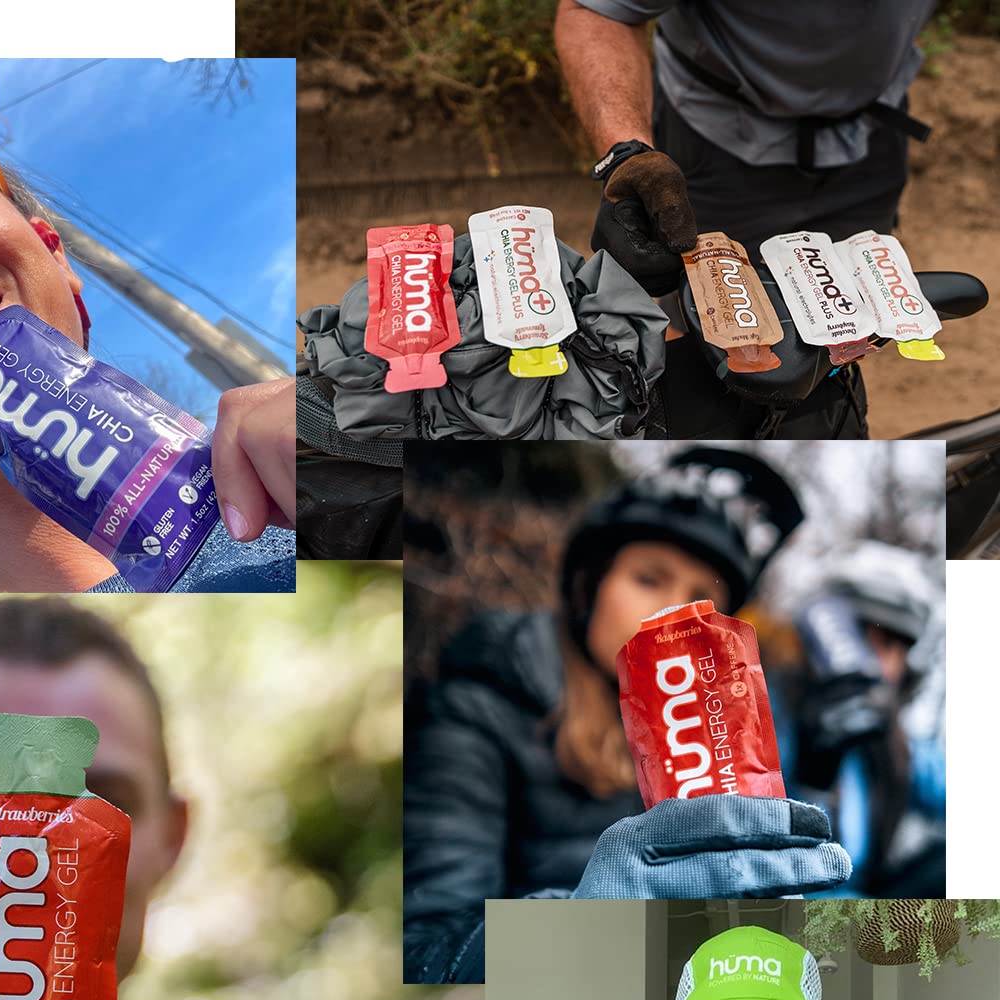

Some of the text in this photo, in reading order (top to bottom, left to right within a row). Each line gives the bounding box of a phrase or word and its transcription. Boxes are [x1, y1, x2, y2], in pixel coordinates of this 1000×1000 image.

[391, 255, 403, 335] CHIA ENERGY GEL
[501, 229, 523, 319] CHIA ENERGY GEL PLUS
[706, 260, 735, 328] CHIA ENERGY GEL
[793, 248, 834, 320] CHIA ENERGY GEL PLUS
[862, 250, 900, 317] CHIA ENERGY GEL PLUS
[17, 363, 88, 412] ENERGY
[87, 404, 134, 442] CHIA
[191, 464, 209, 485] VEGAN
[196, 467, 213, 490] FRIEND
[153, 507, 175, 534] GLUTEN
[159, 523, 175, 539] FREE
[165, 539, 182, 559] NET
[654, 626, 702, 645] Raspberries
[699, 648, 739, 796] HIA ENERGY GEL
[56, 838, 80, 886] GEL
[53, 893, 78, 994] ENERGY
[753, 973, 781, 986] NATURE
